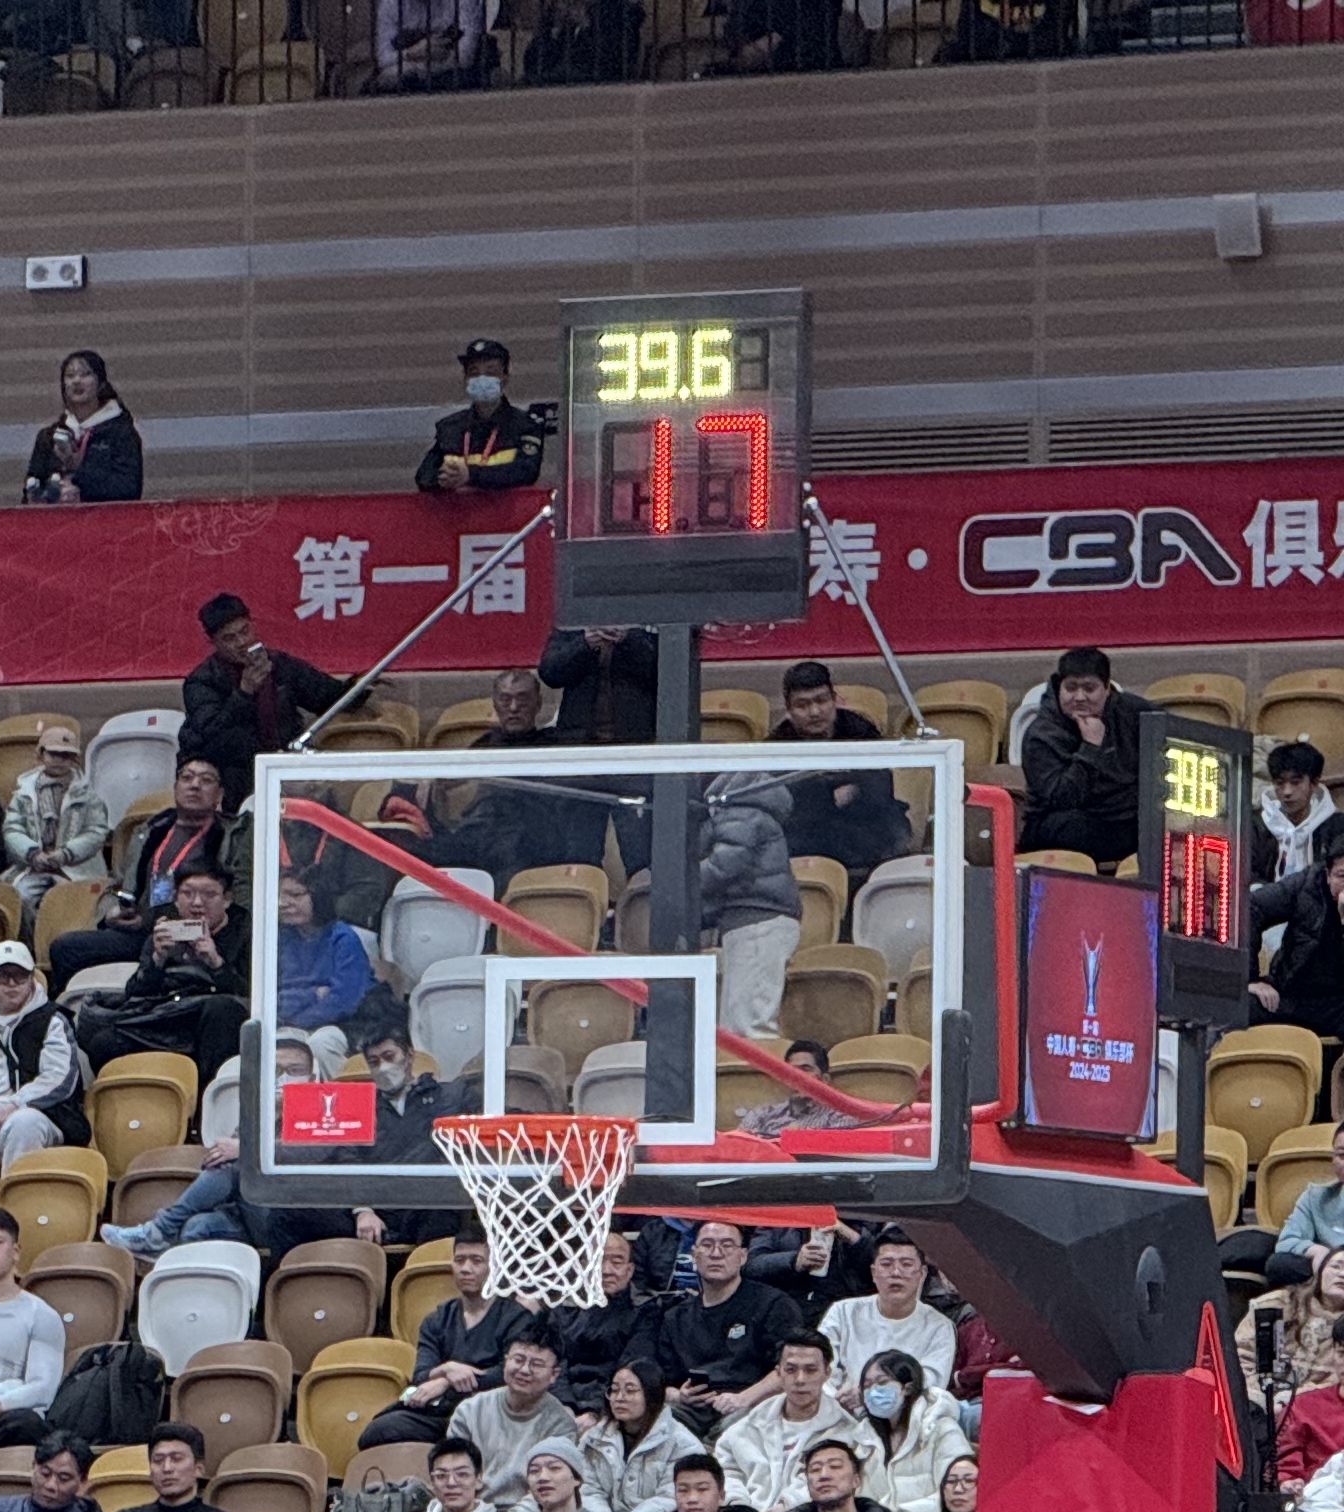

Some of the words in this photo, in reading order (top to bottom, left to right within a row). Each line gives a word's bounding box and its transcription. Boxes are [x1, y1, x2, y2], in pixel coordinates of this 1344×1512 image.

[598, 328, 733, 402] 39.6
[653, 414, 768, 534] 17
[294, 533, 525, 620] 第一届
